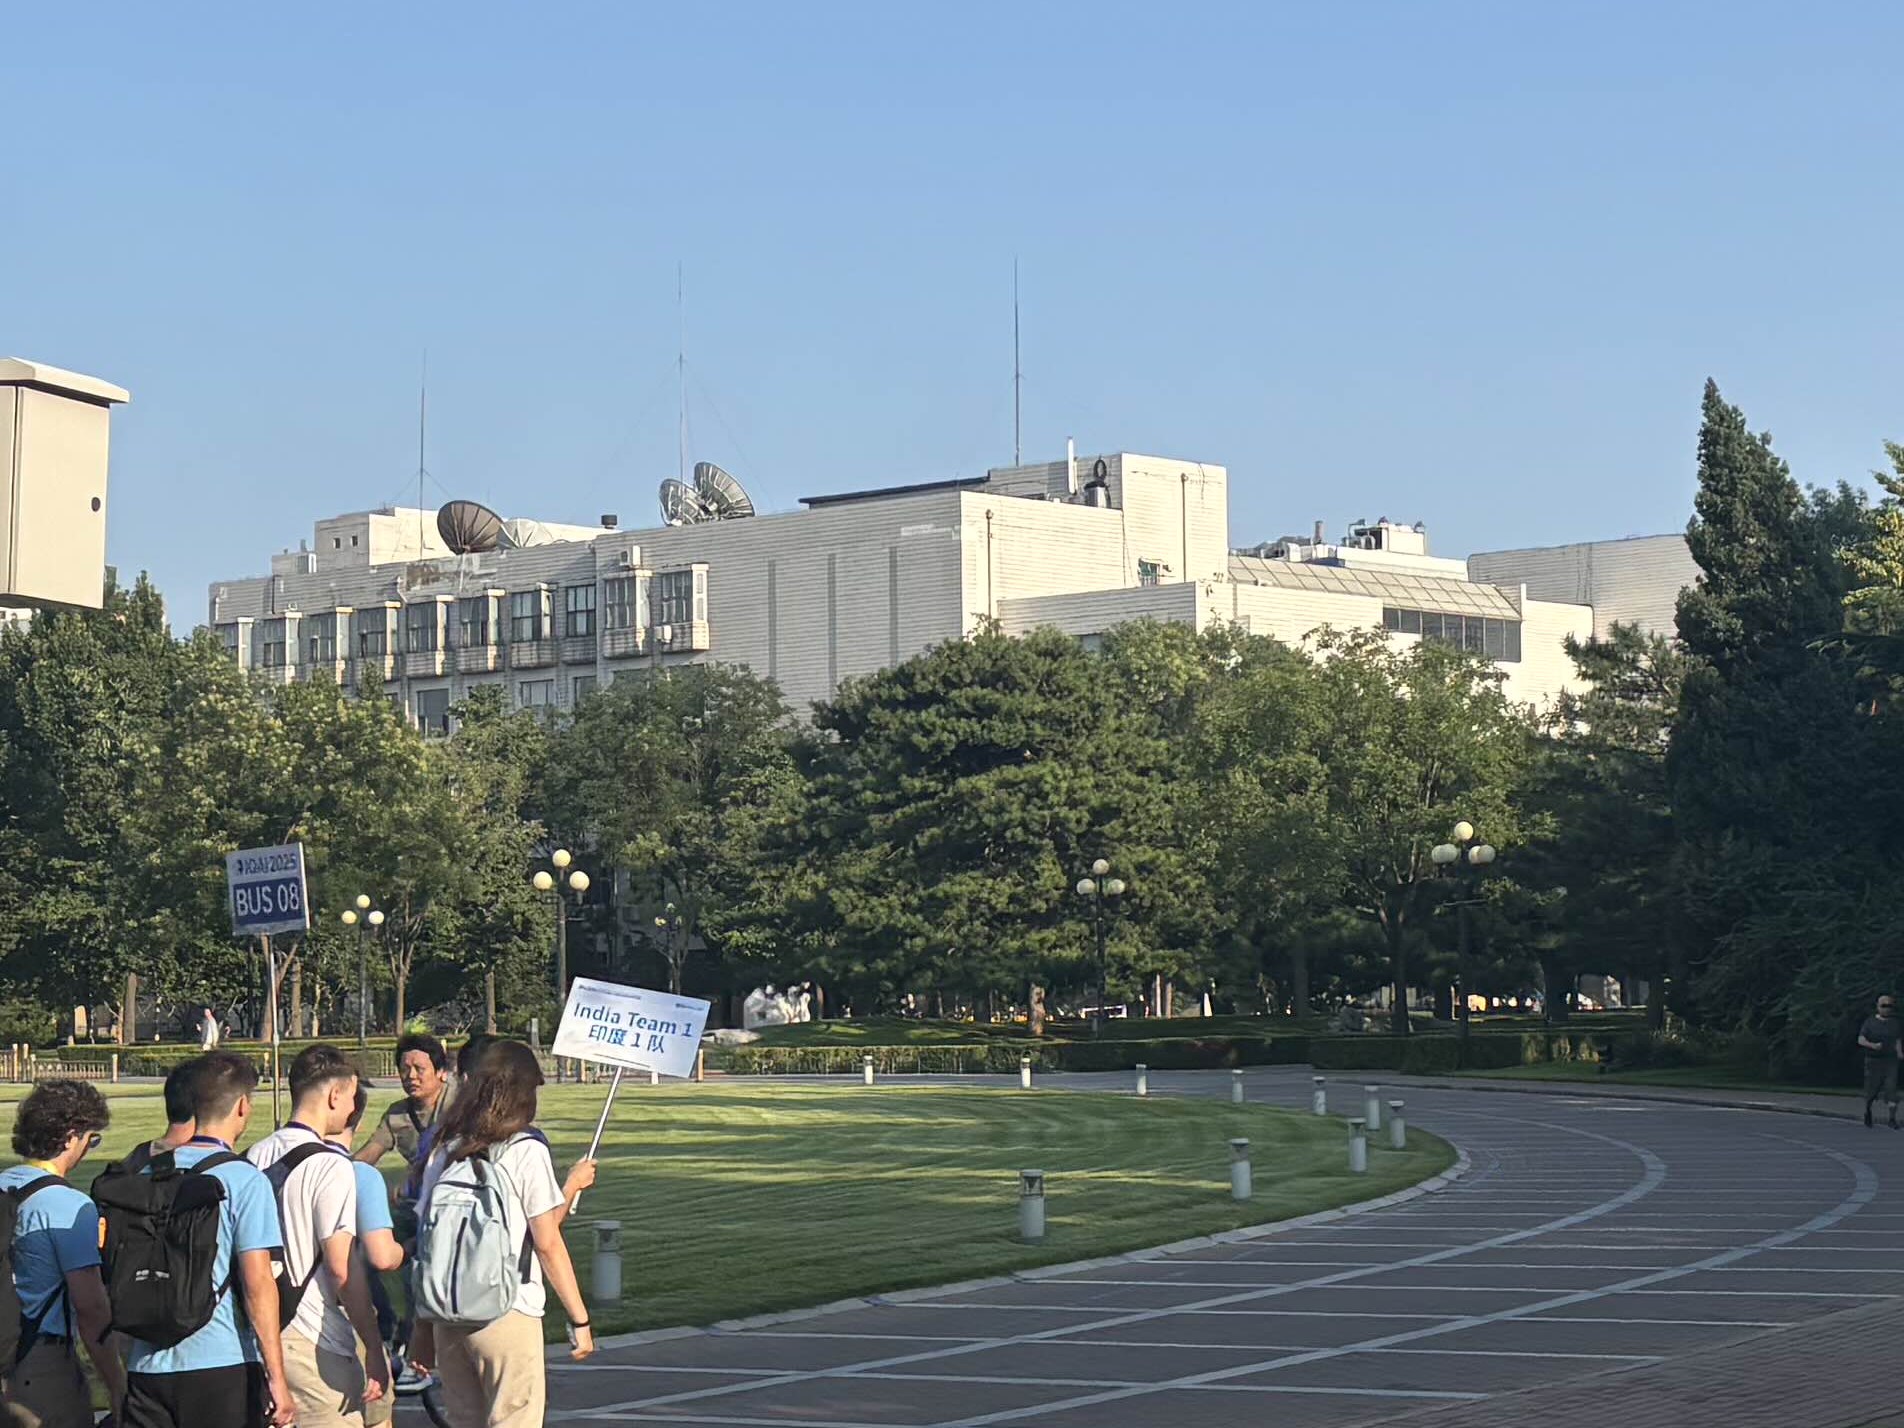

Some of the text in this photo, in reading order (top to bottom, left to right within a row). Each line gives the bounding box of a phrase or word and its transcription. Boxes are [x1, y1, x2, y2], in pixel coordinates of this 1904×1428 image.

[236, 882, 300, 916] BUS 08
[574, 1002, 694, 1038] India Team 1
[588, 1024, 665, 1054] 印度 1 队
